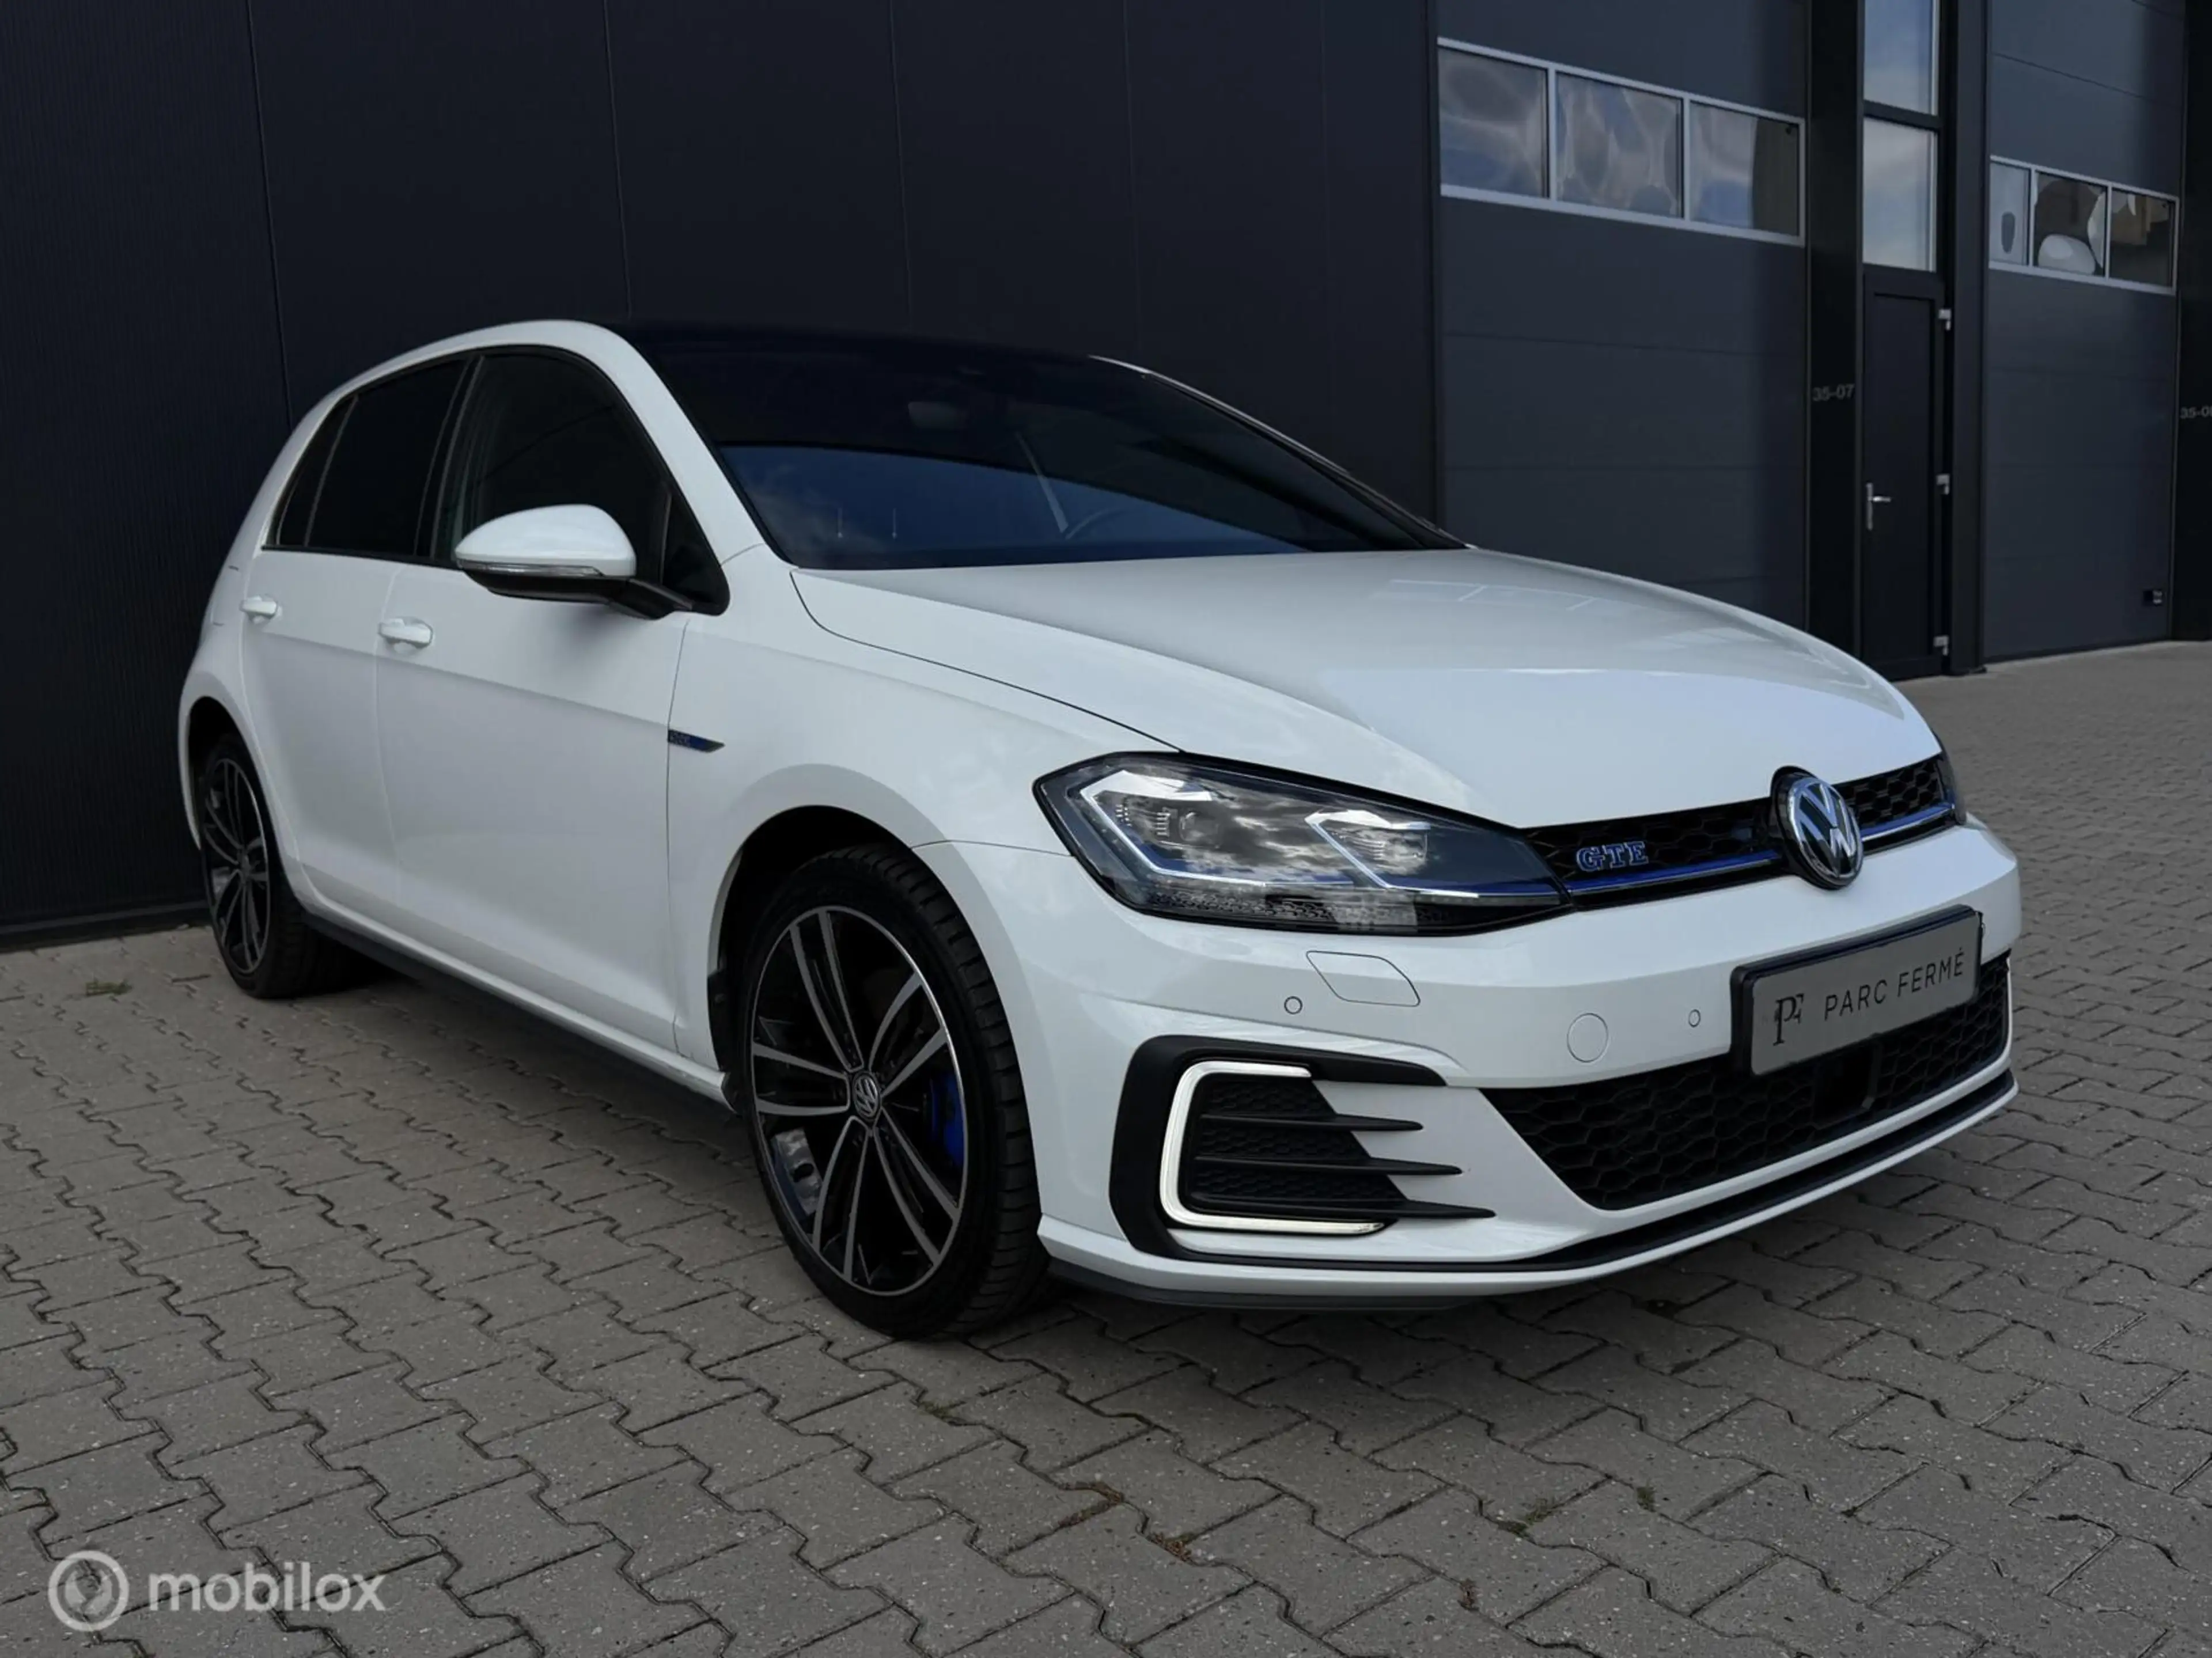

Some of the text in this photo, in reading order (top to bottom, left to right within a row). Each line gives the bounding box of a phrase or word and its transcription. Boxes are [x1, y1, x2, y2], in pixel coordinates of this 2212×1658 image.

[2180, 405, 2212, 419] 35-0
[1575, 841, 1649, 872] GTE
[1824, 980, 1887, 1021] PARC
[1897, 947, 1965, 997] FERMÉ
